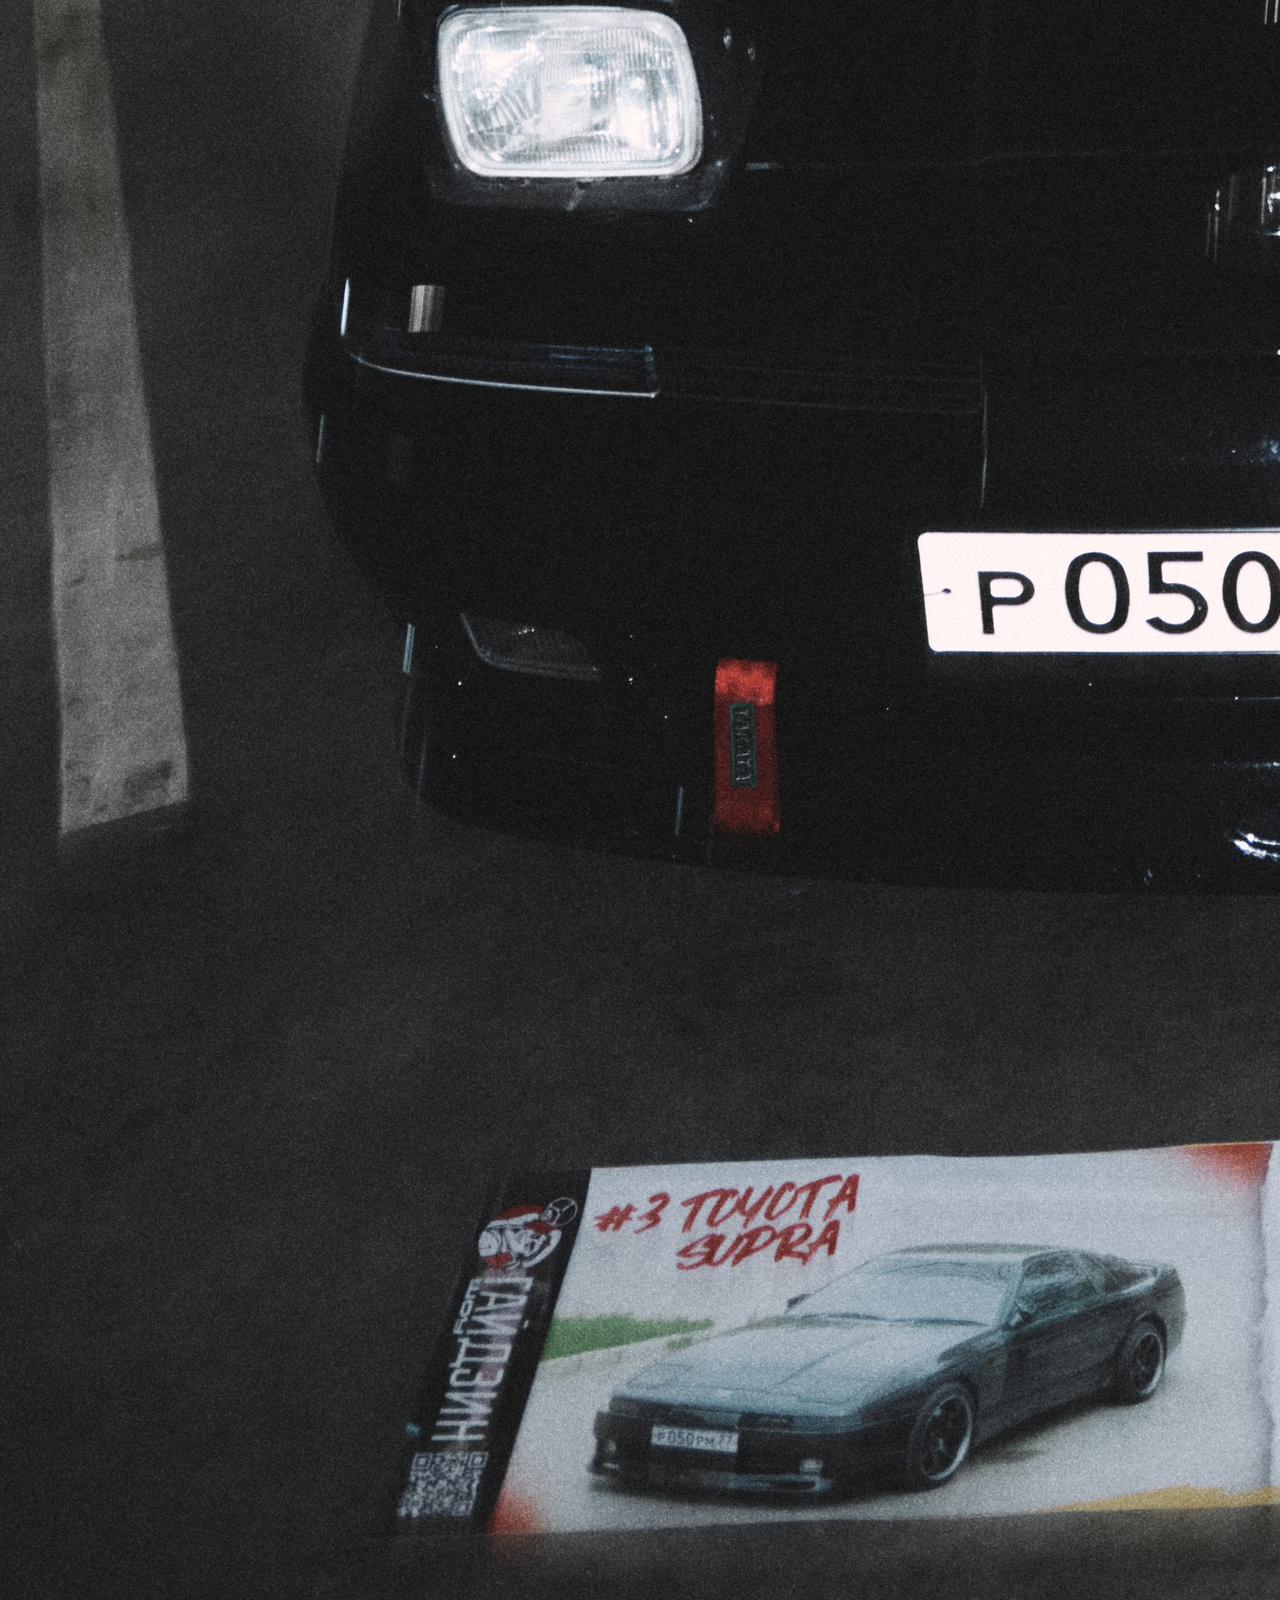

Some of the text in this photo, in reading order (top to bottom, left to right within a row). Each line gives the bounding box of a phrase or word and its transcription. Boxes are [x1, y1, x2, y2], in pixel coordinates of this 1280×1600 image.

[680, 1173, 860, 1234] TOYOTA
[676, 1218, 841, 1271] SUPRA
[431, 1276, 534, 1441] ГАЙДЗИН
